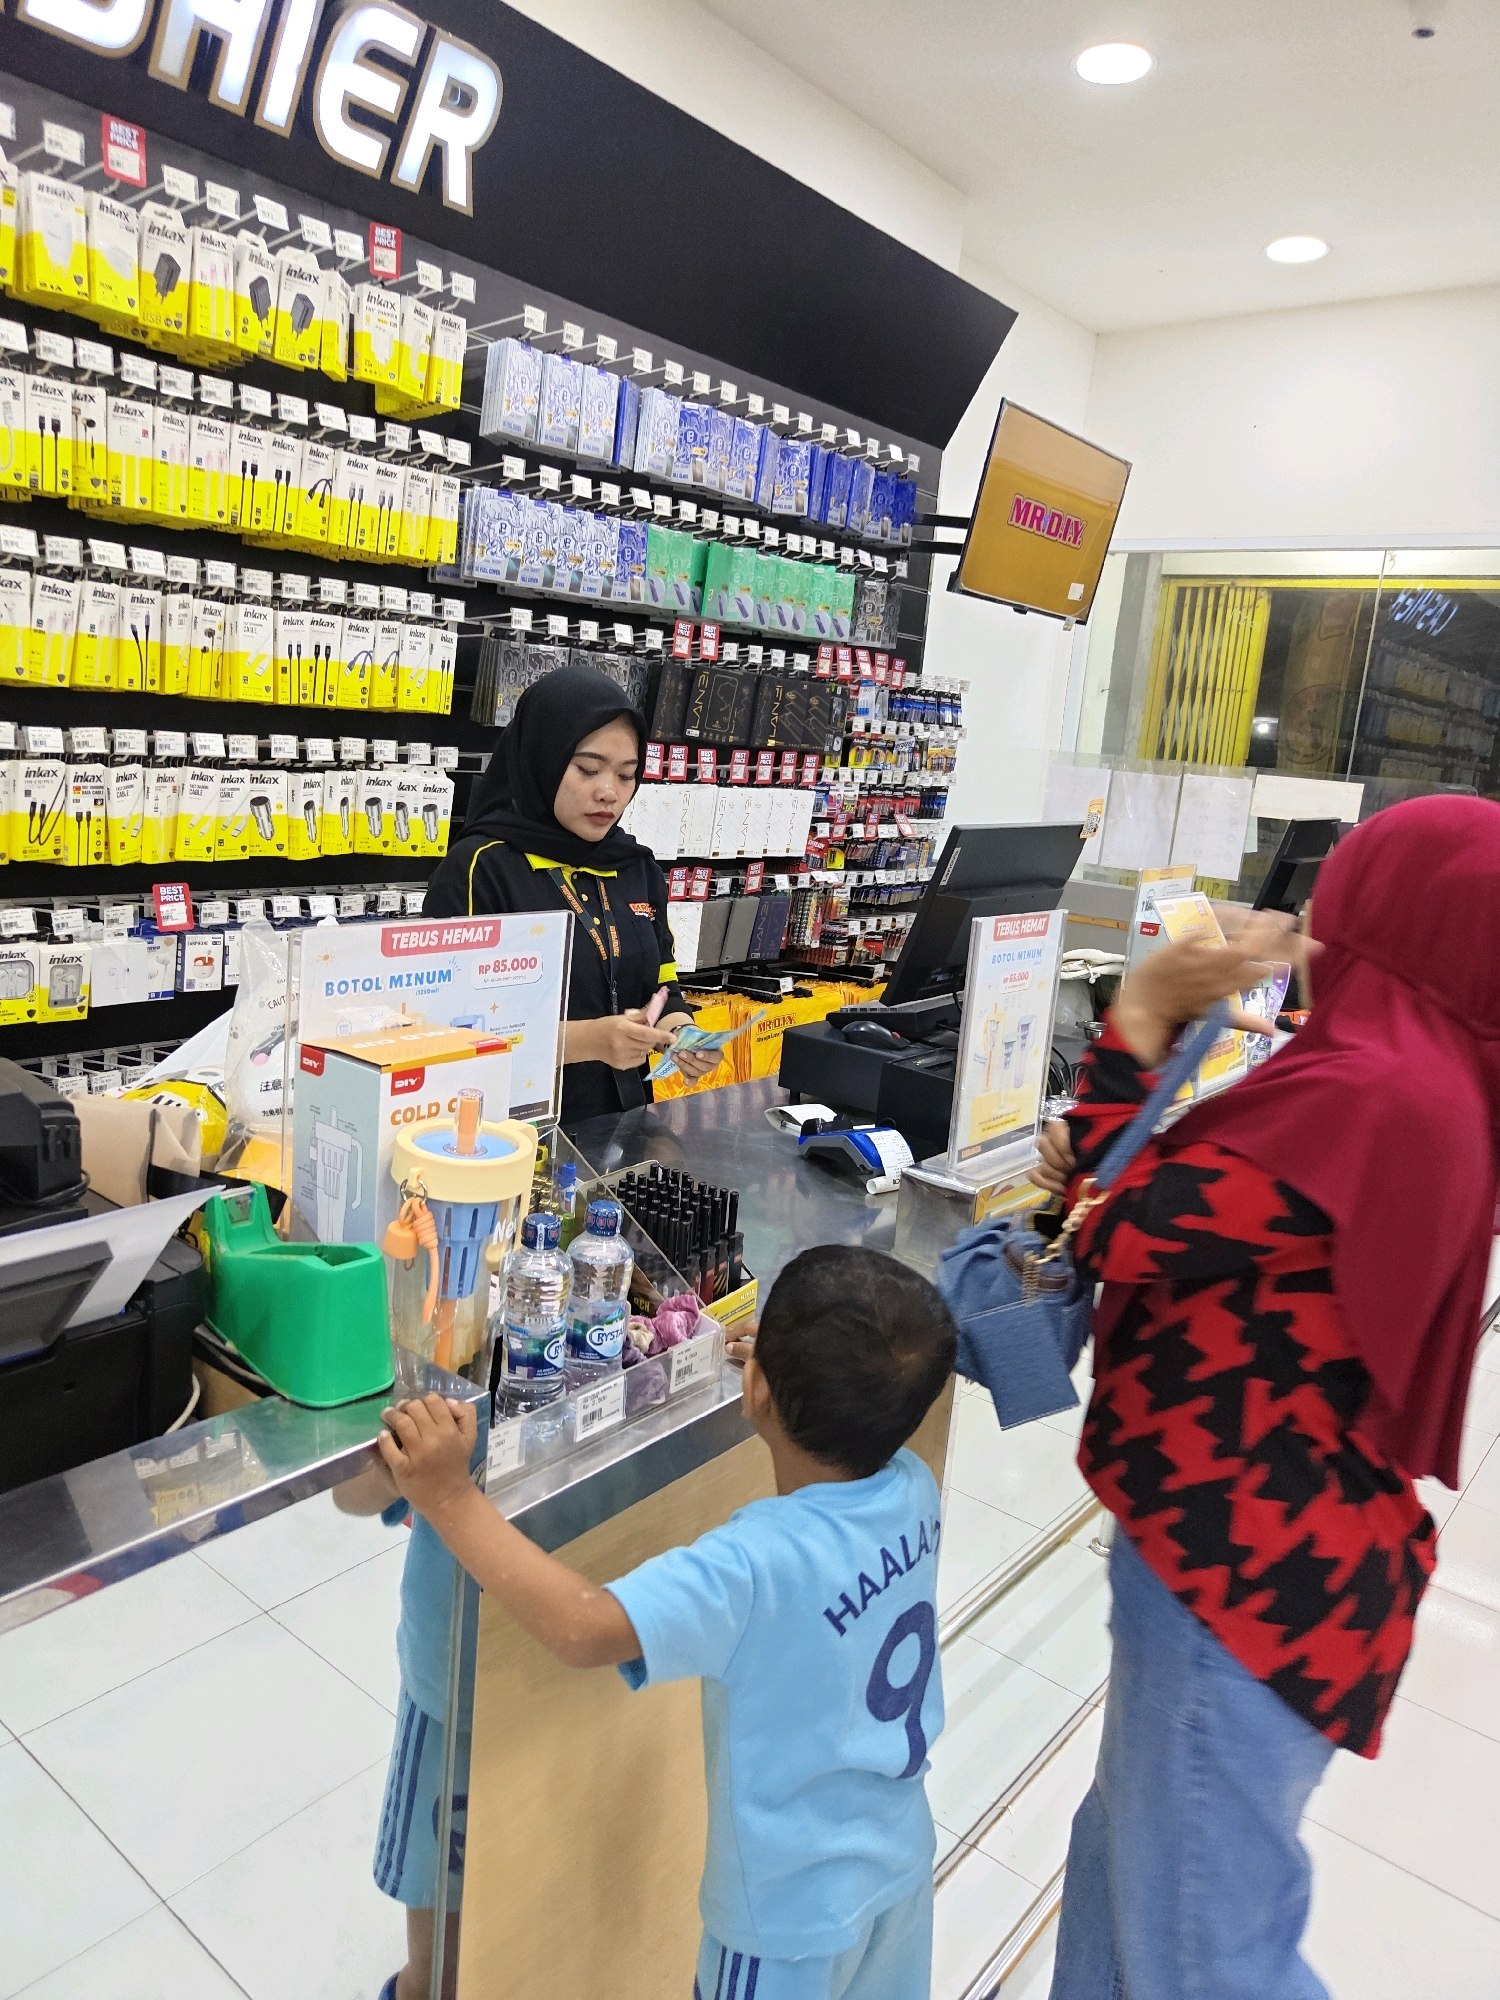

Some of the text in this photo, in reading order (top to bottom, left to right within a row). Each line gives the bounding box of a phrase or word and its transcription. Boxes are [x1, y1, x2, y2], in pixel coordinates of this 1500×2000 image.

[109, 120, 139, 143] BEST
[109, 132, 140, 152] PRICE
[37, 182, 76, 202] inkax
[98, 199, 131, 223] inkax
[148, 223, 186, 245] inkax
[374, 226, 396, 239] BEST
[200, 231, 228, 250] inkax
[374, 236, 397, 249] PRICE
[248, 249, 276, 273] inkax
[286, 265, 320, 285] inkax
[367, 290, 397, 312] inkax
[31, 380, 64, 397] inkax
[72, 390, 96, 404] kax
[113, 402, 145, 418] inkax
[162, 412, 185, 428] inkax
[197, 420, 225, 436] inkax
[238, 430, 263, 445] inkax
[272, 437, 296, 453] inkax
[347, 457, 370, 471] inkax
[376, 466, 398, 480] inkax
[40, 581, 73, 598] inkax
[92, 586, 116, 601] inkax
[131, 592, 156, 605] inkax
[203, 606, 222, 618] inkax
[243, 608, 268, 622] inkax
[282, 616, 305, 626] inkax
[310, 617, 336, 630] inkax
[348, 622, 370, 634] inkax
[678, 623, 691, 631] BEST
[24, 766, 58, 778] inkax
[73, 771, 102, 783] inkax
[116, 772, 138, 784] inkax
[156, 774, 175, 784] inkax
[190, 771, 214, 782] inkax
[220, 774, 246, 784] inkax
[250, 774, 280, 785] inkax
[303, 779, 322, 790] inkax
[366, 776, 393, 787] inkax
[422, 784, 448, 794] inkax
[943, 850, 960, 883] Lenovo
[160, 886, 184, 895] BEST
[160, 894, 185, 902] PRICE
[996, 918, 1047, 936] TEBUS HEMAT
[392, 926, 493, 950] TEBUS HEMAT
[0, 950, 26, 960] inkax
[49, 954, 82, 964] inkax
[992, 948, 1042, 964] BOTOL MINUM
[479, 957, 538, 975] RP 85.000
[325, 969, 452, 996] BOTOL MINUM
[302, 1058, 320, 1068] DIY
[395, 1078, 418, 1088] DIY
[390, 1101, 441, 1126] COLD
[588, 1328, 624, 1346] CRYSTA
[866, 1600, 936, 1779] 9
